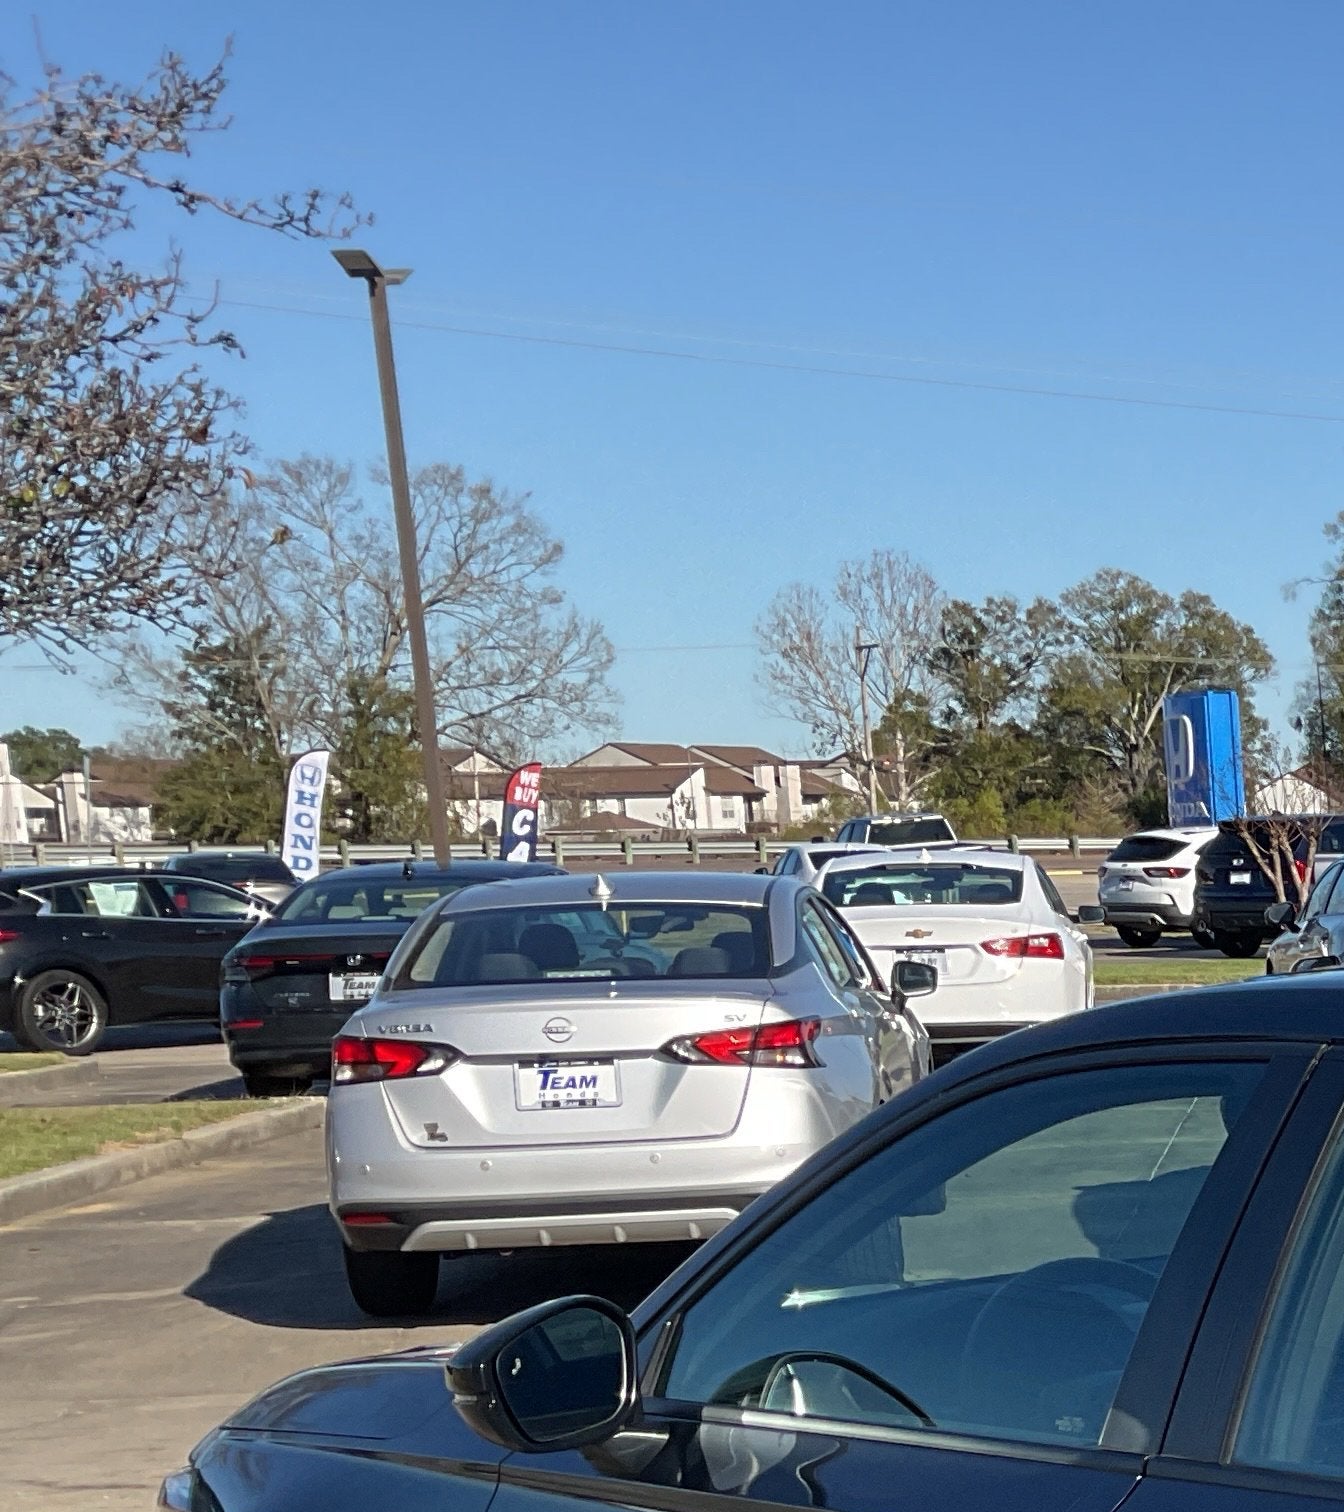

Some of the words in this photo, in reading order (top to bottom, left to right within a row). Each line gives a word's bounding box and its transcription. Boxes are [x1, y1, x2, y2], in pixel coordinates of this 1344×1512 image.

[520, 770, 540, 788] WE
[341, 978, 377, 989] TEAM
[377, 1023, 434, 1034] VERSA
[537, 1069, 598, 1090] TEAM
